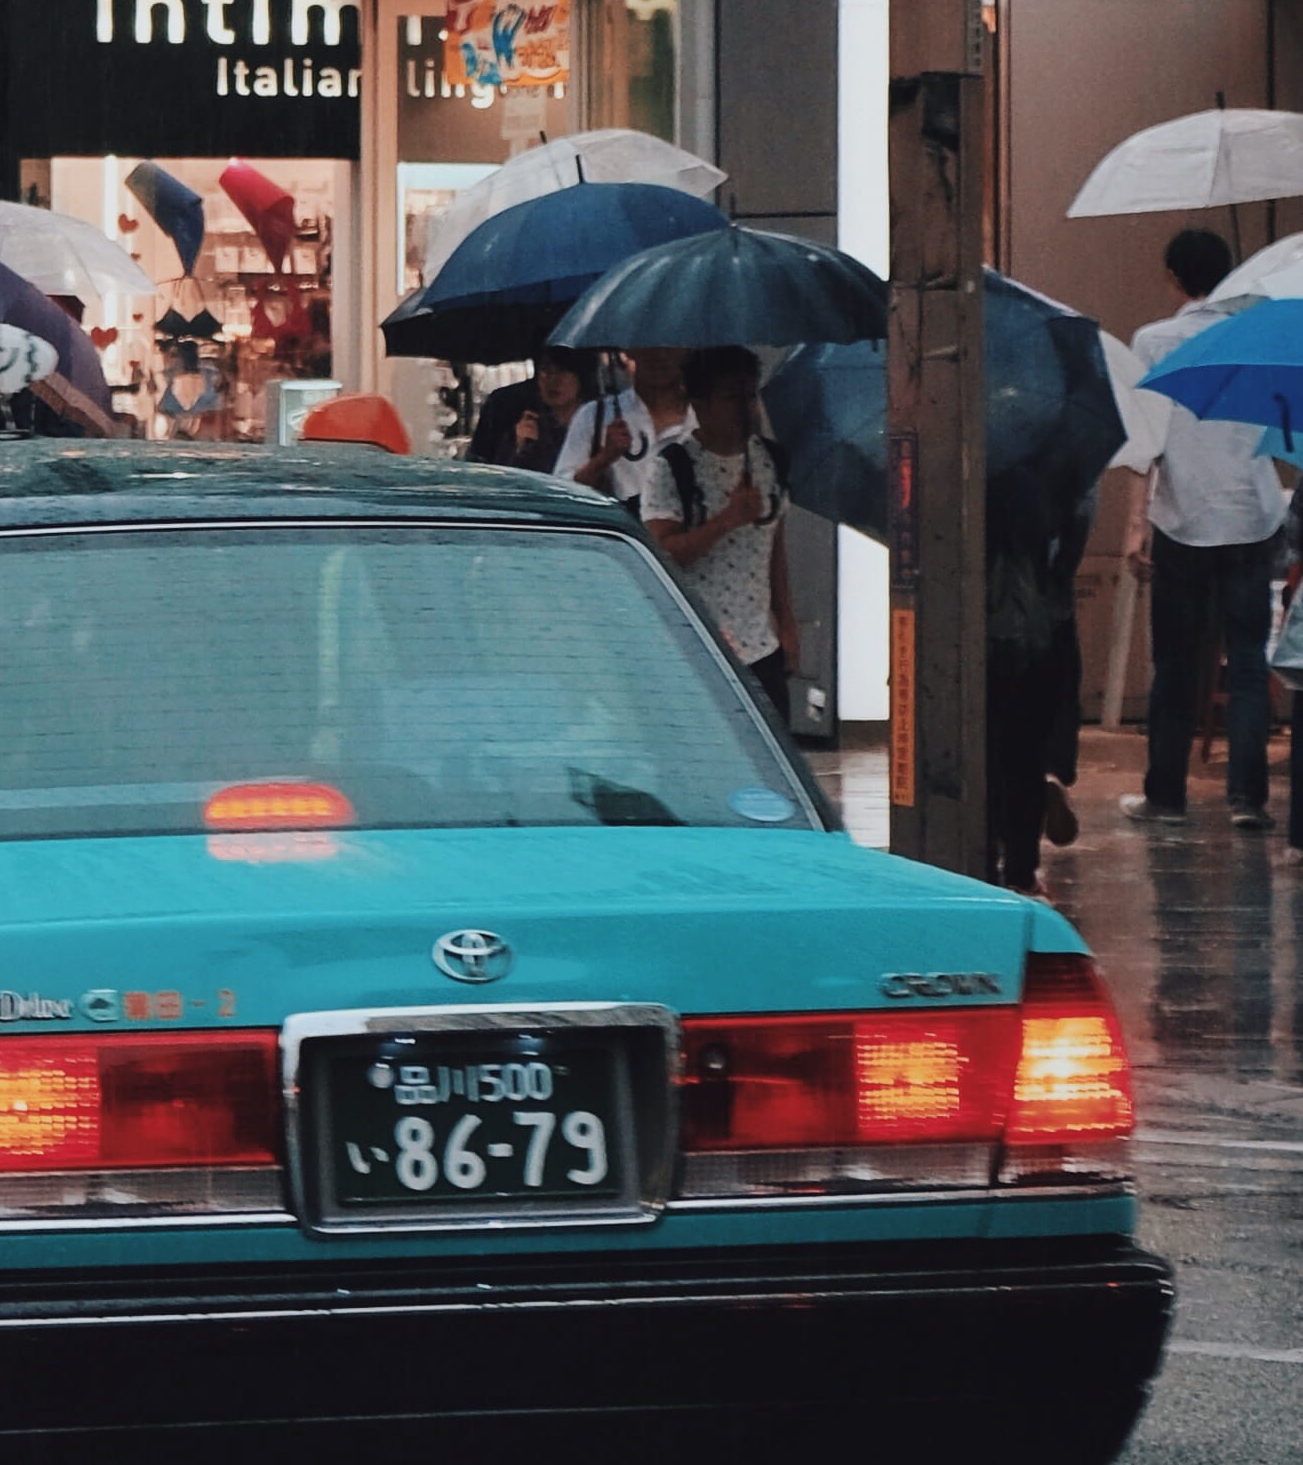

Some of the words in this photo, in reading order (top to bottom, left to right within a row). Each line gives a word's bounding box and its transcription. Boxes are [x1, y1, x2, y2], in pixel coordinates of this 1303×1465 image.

[881, 971, 1001, 999] CROWN
[395, 1063, 472, 1105] 品川
[395, 1110, 607, 1191] 86-79
